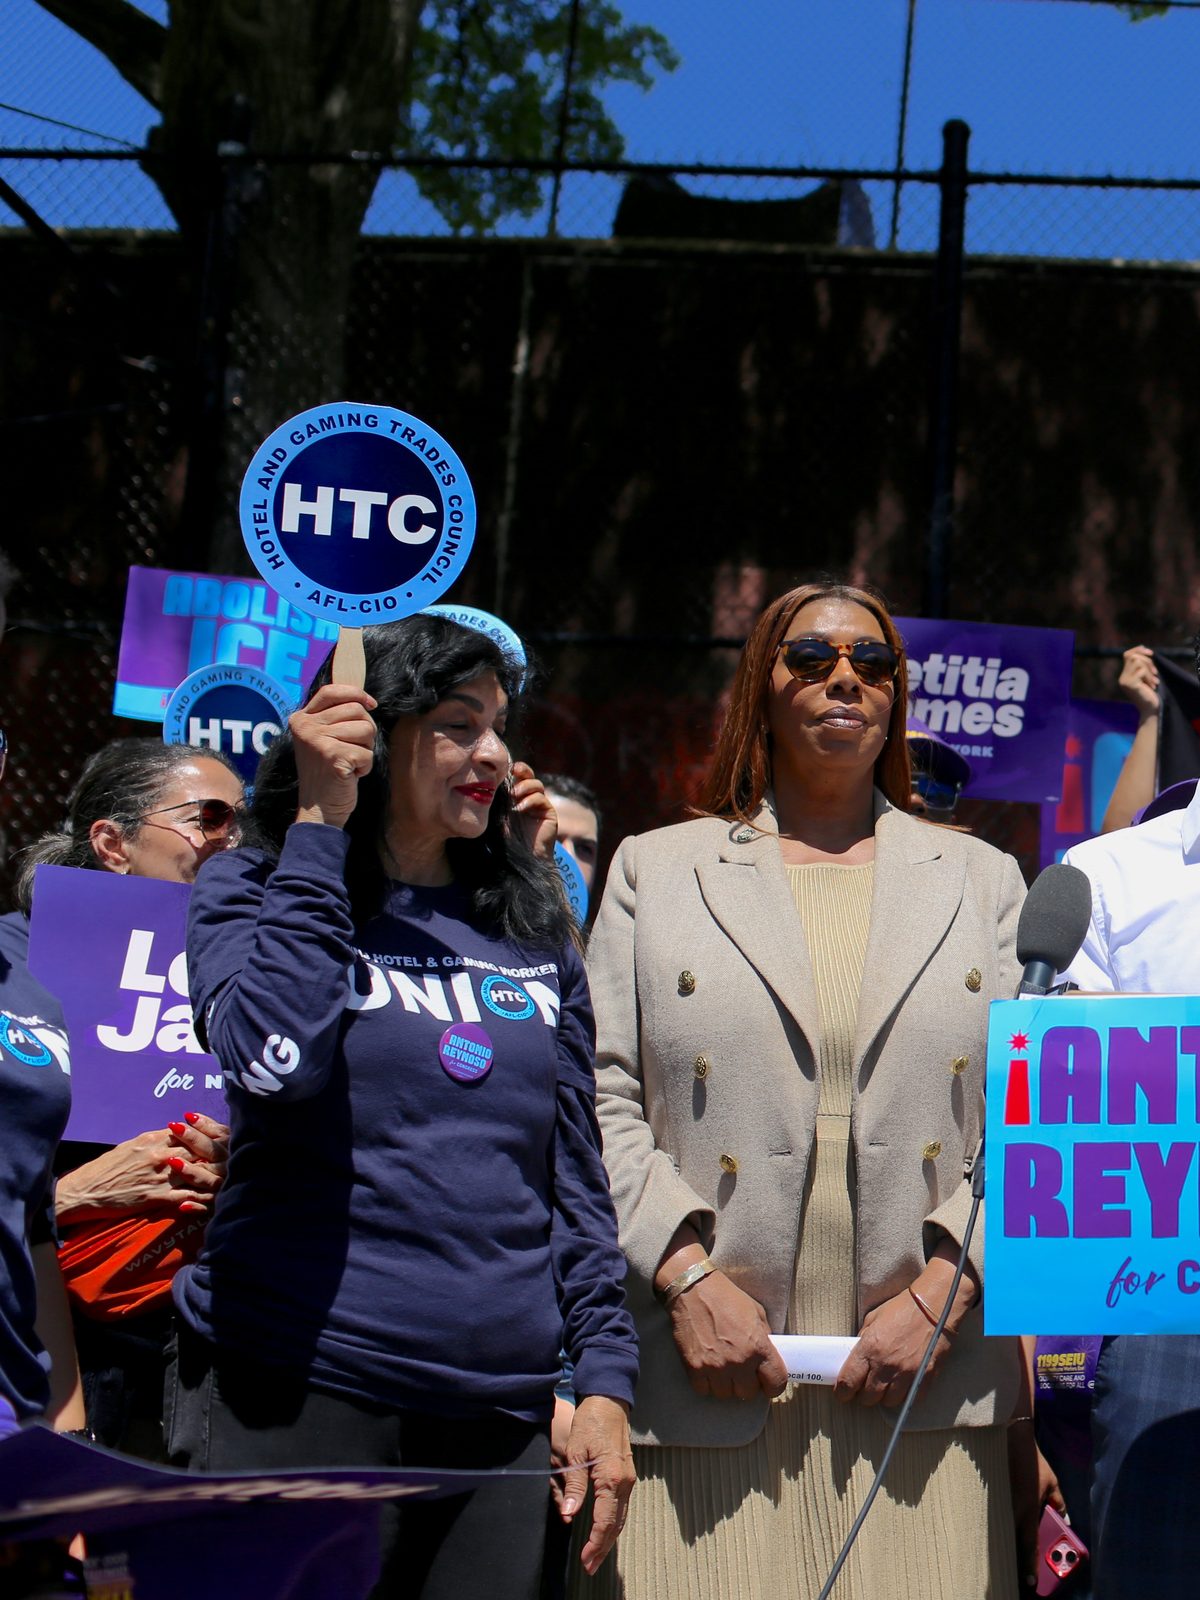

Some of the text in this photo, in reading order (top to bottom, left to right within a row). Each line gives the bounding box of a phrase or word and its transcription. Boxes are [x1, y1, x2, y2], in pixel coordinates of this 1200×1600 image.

[253, 412, 464, 585] HOTEL AND GAMING TRADES COUNCIL
[281, 482, 438, 545] HTC
[307, 589, 398, 614] AFL-CIO
[173, 695, 191, 723] AND
[190, 671, 243, 694] GAMING
[906, 698, 1025, 738] mes
[188, 716, 281, 756] HTC
[372, 953, 423, 968] HOTEL
[426, 957, 438, 967] &
[442, 956, 499, 972] GAMING
[490, 989, 527, 1002] HTC
[442, 1044, 487, 1069] REYNOSO
[449, 1034, 492, 1060] ANTONIO
[153, 1067, 194, 1098] for
[1106, 1255, 1166, 1309] for
[1037, 1353, 1086, 1367] 1199SEIU
[807, 1373, 824, 1382] 100,
